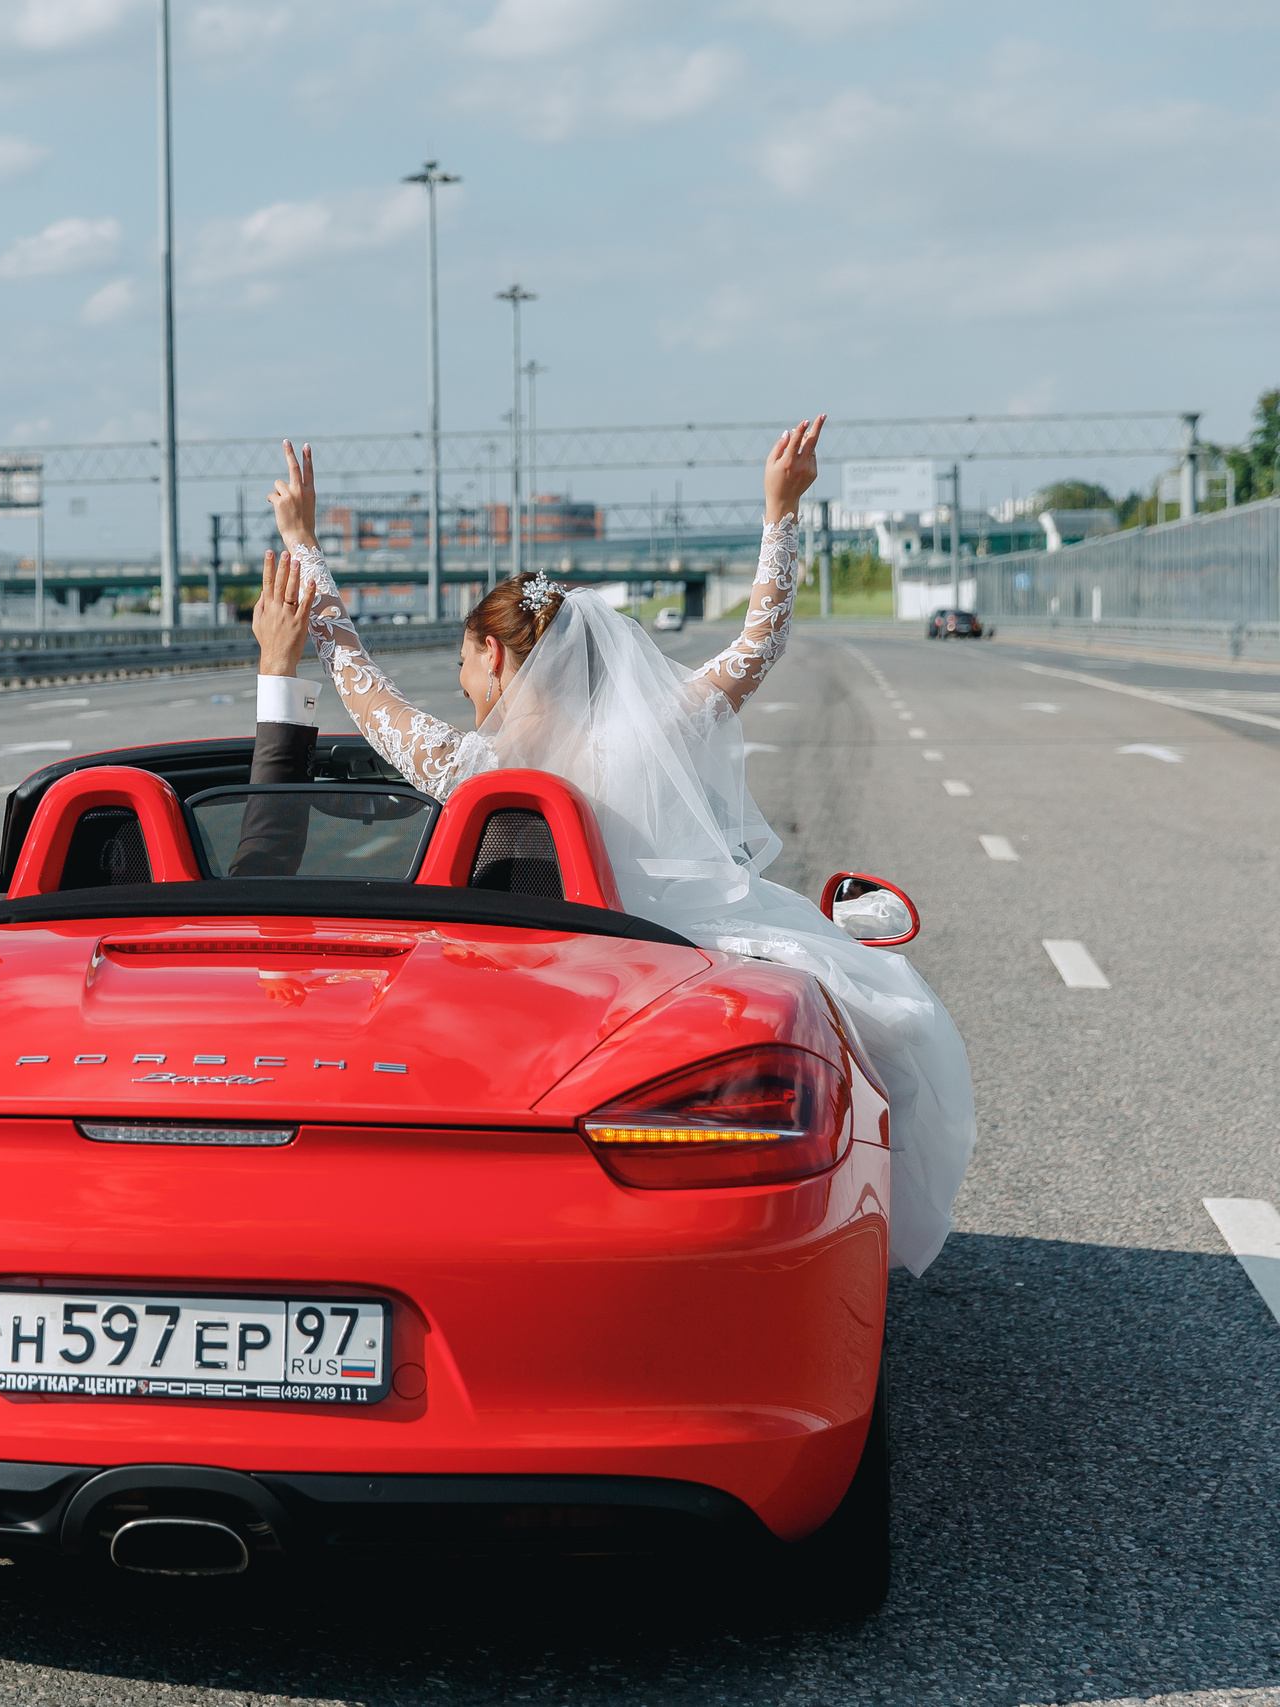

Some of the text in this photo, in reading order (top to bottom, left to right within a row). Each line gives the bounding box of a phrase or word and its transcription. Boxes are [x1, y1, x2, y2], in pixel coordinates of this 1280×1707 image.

[15, 1053, 410, 1075] PORSCHE
[294, 1306, 360, 1356] 97
[291, 1358, 338, 1375] RUS
[148, 1381, 280, 1399] PORSCHE
[280, 1385, 311, 1399] (495)
[314, 1386, 336, 1399] 249
[340, 1387, 351, 1400] 11
[357, 1387, 367, 1400] 11
